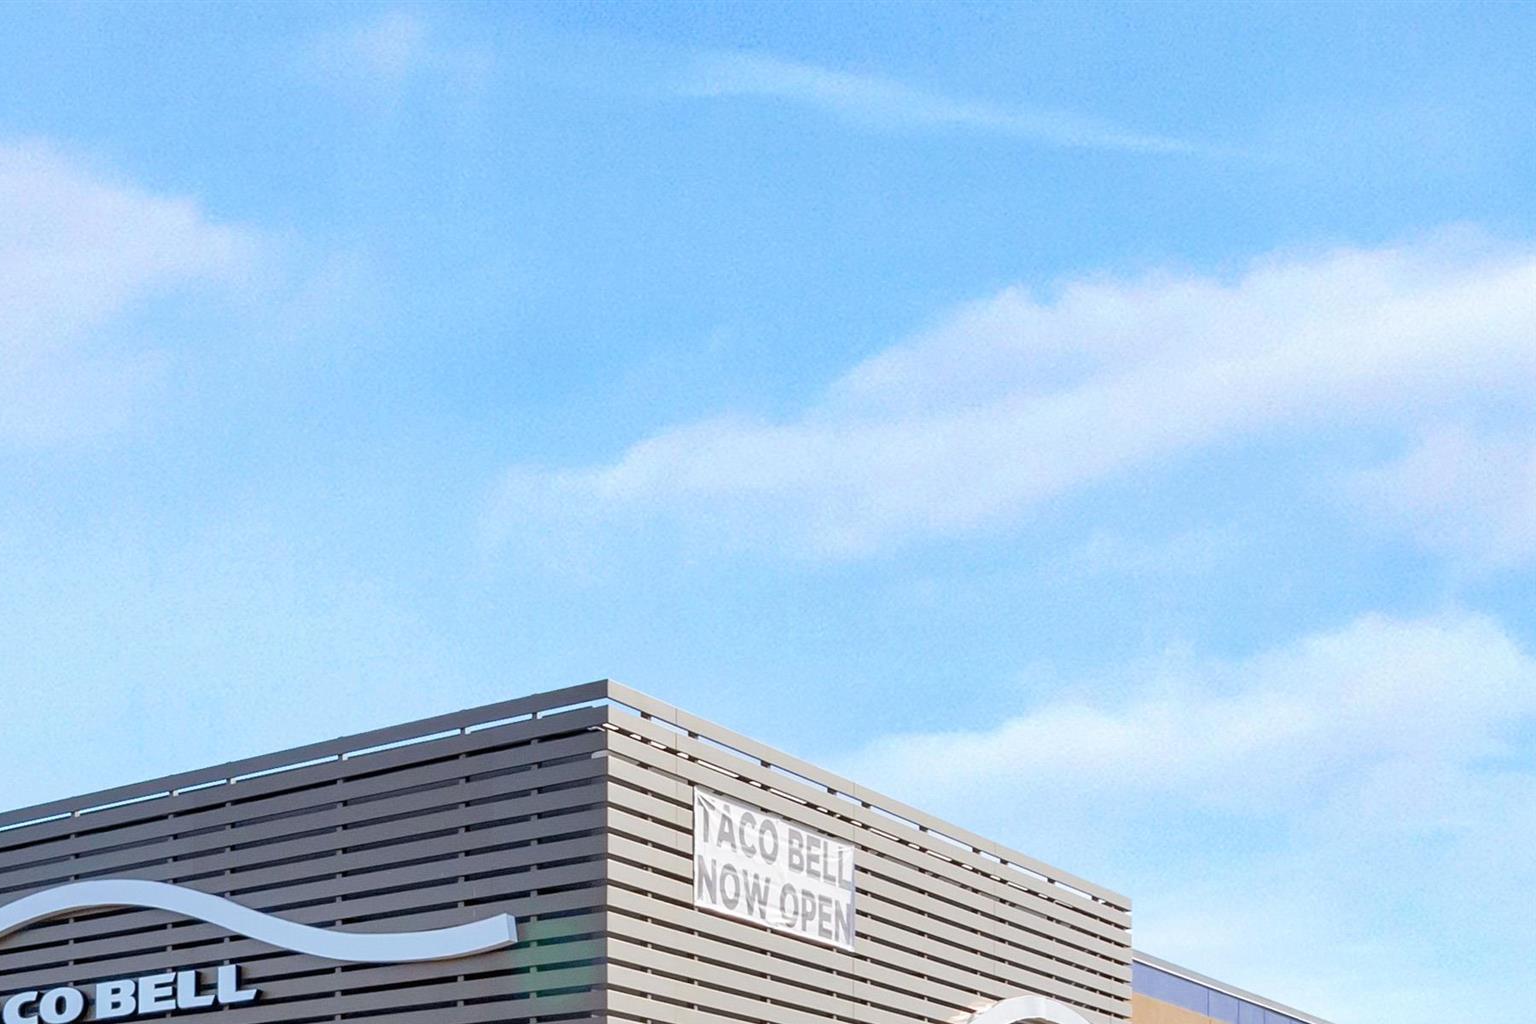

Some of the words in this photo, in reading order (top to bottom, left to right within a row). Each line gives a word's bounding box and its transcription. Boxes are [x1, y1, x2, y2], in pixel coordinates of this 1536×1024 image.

[697, 795, 779, 865] TACO
[788, 828, 852, 891] BELL
[697, 855, 771, 919] NOW
[779, 883, 853, 945] OPEN
[95, 963, 258, 1020] BELL
